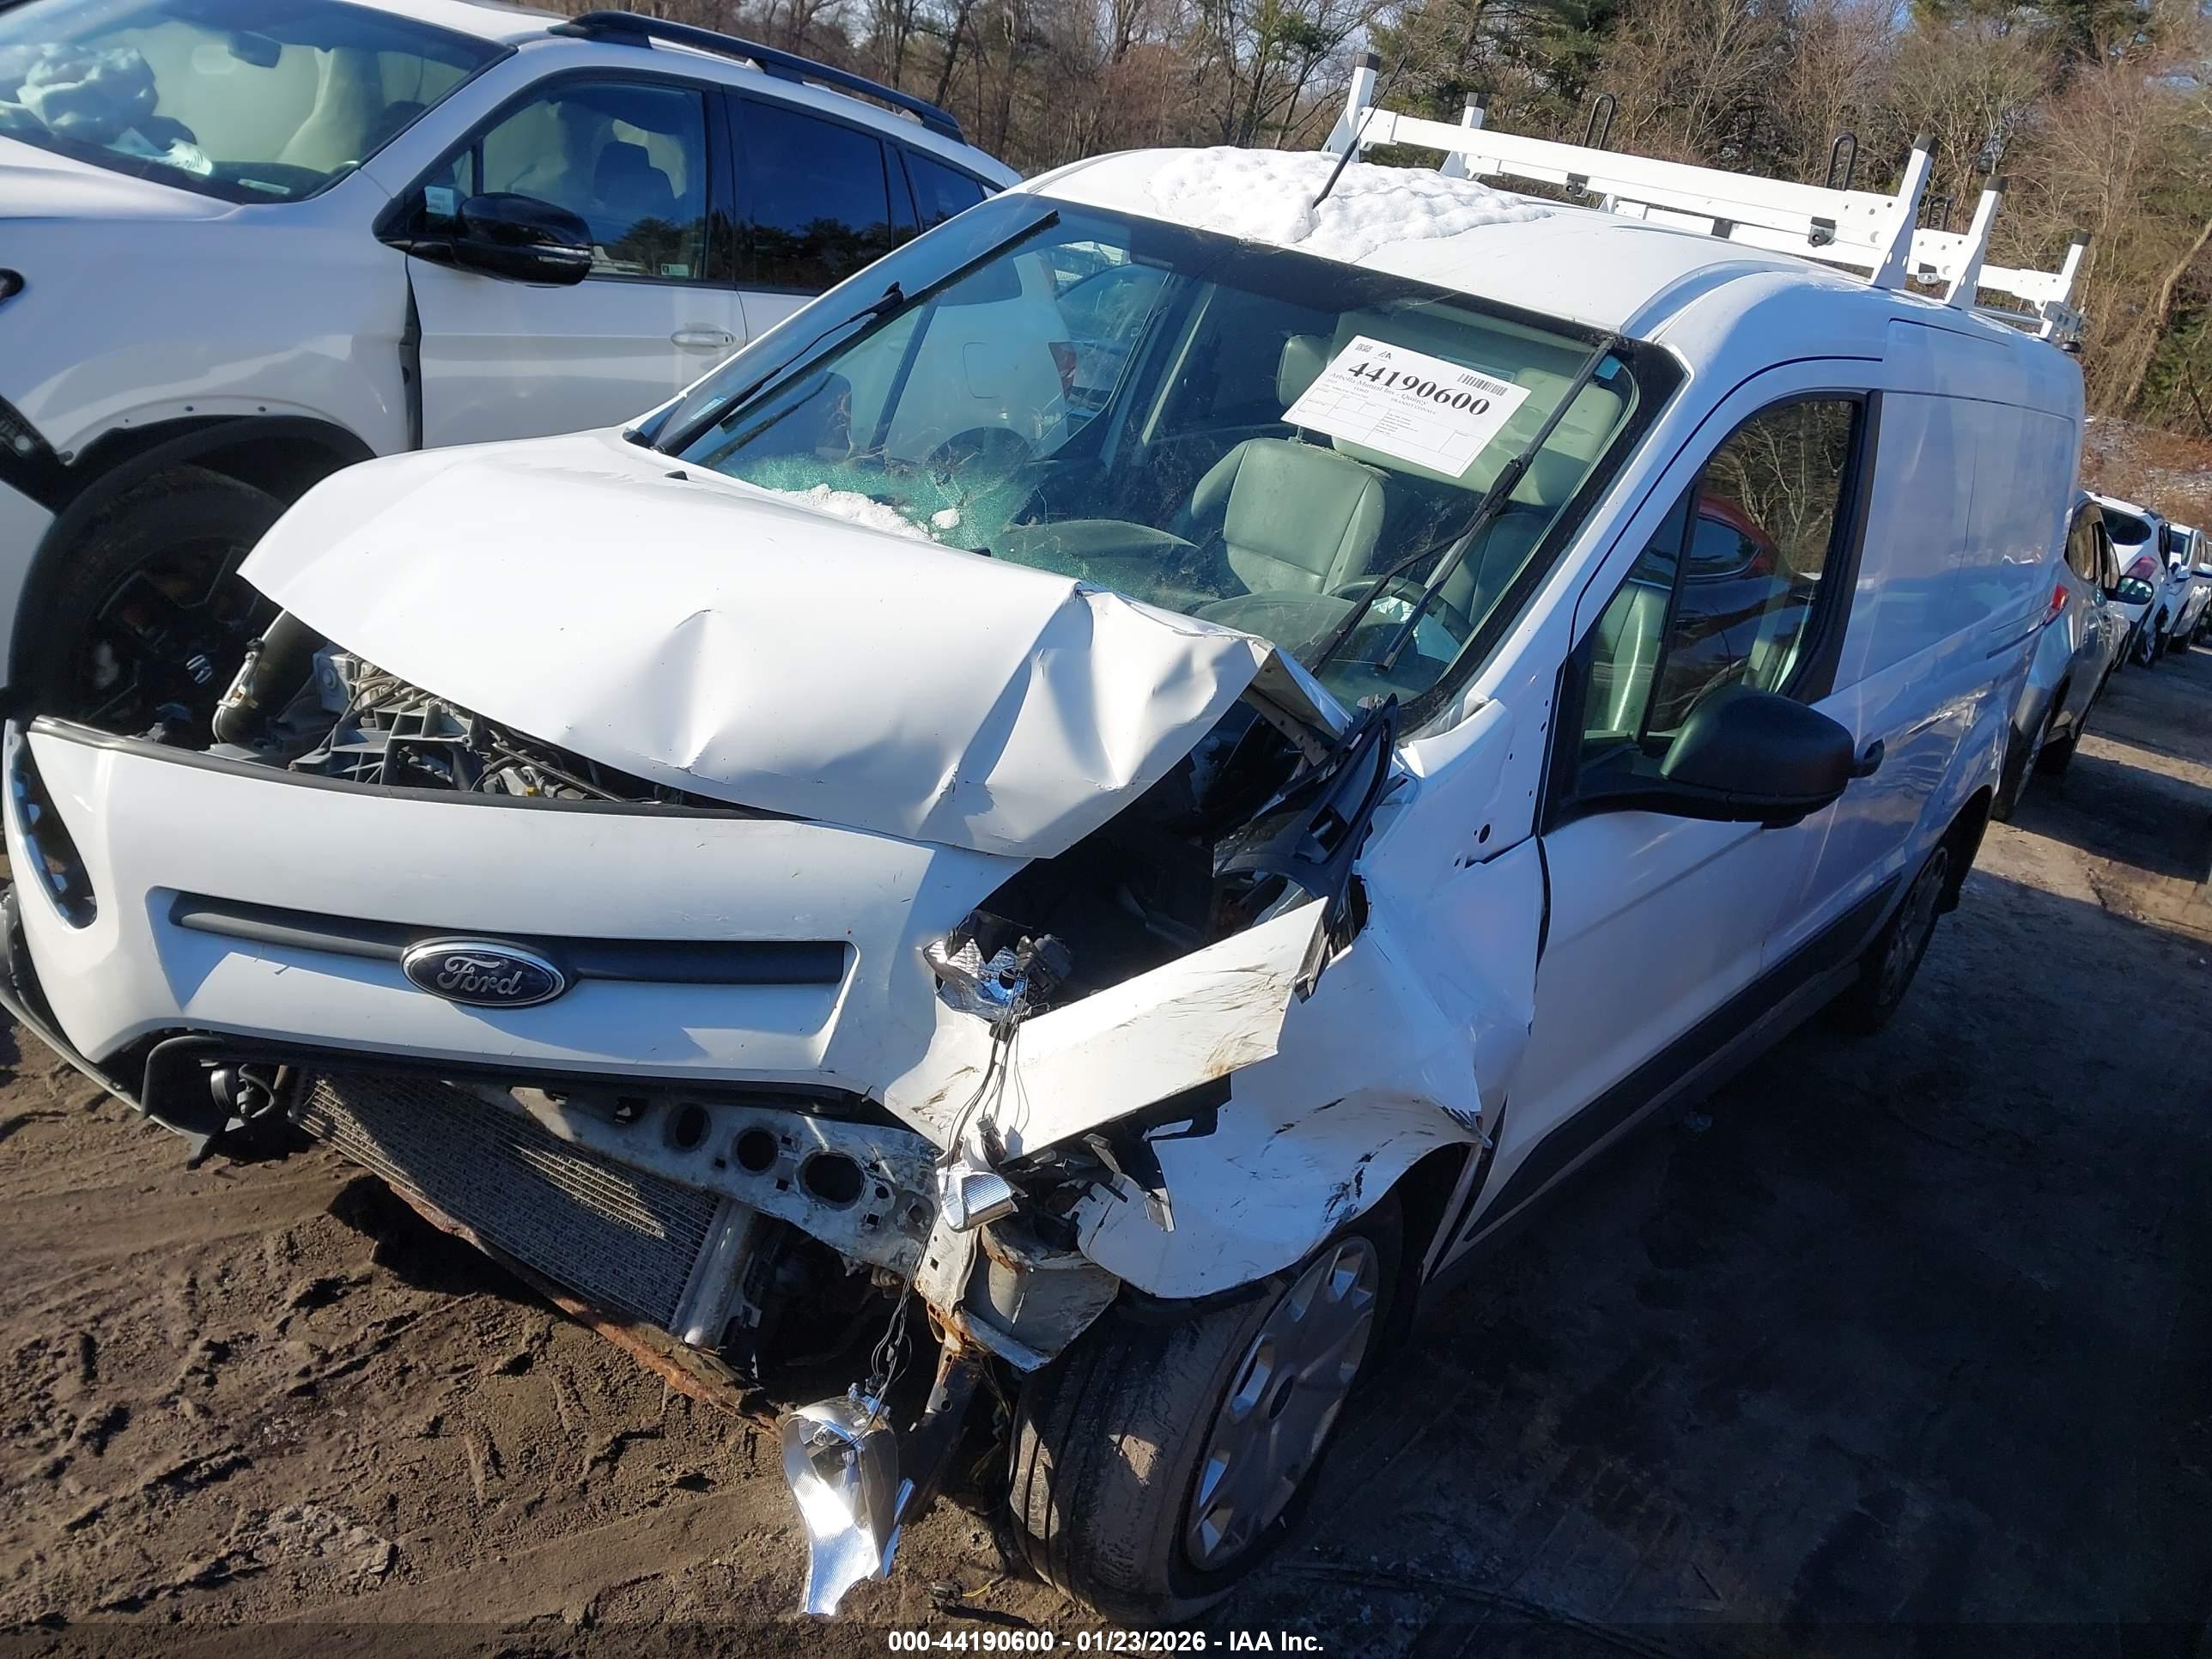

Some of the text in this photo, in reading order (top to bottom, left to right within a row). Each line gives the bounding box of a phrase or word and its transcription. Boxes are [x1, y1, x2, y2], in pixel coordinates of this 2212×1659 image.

[1329, 372, 1356, 384] Arbella
[1357, 380, 1385, 392] Mutual
[1401, 393, 1429, 406] Quincy
[1347, 362, 1491, 416] 44190600
[436, 956, 523, 996] Ford
